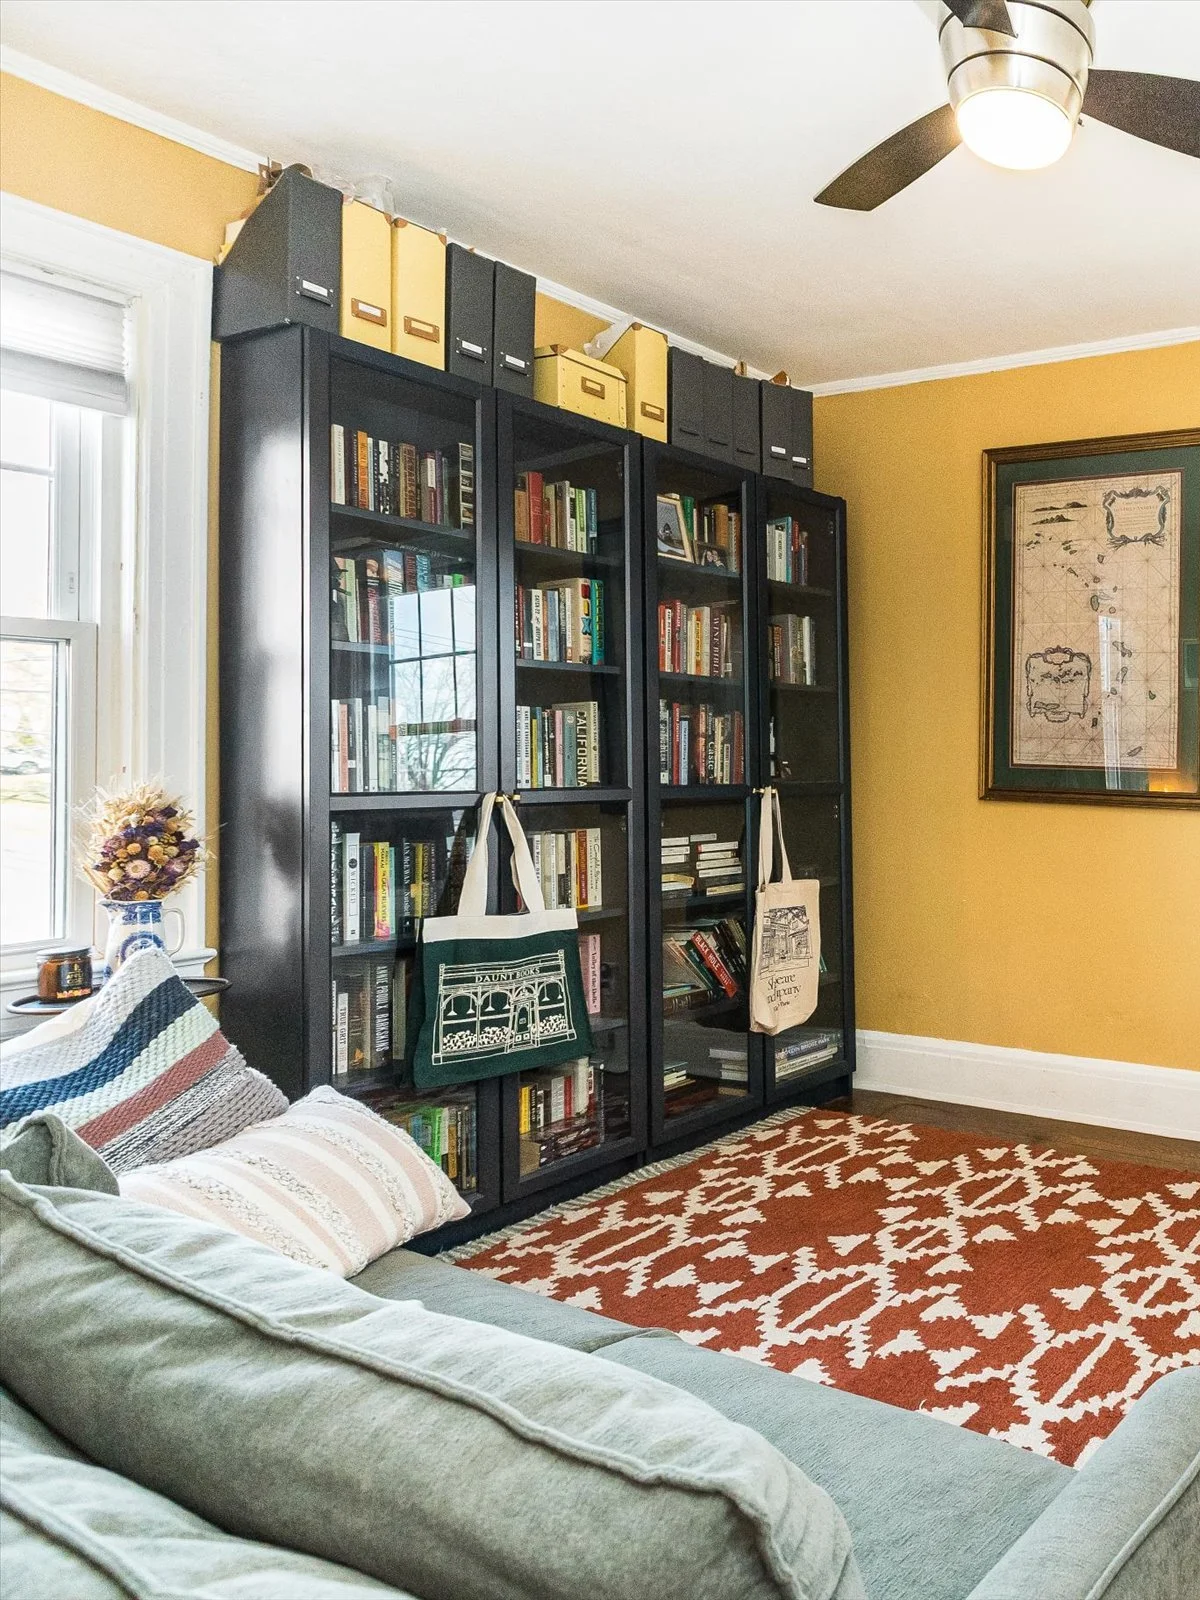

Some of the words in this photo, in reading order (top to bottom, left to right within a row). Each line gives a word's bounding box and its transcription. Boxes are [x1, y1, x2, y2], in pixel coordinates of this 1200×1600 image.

[712, 617, 720, 645] WINE
[712, 646, 720, 677] BIBLE
[576, 711, 588, 788] CALIFORNIA
[707, 741, 716, 771] Caste
[403, 842, 411, 854] IAN
[591, 844, 601, 869] Complete
[403, 855, 411, 884] McEWAN
[350, 871, 358, 904] WICKED
[403, 891, 411, 917] Nutshell
[694, 934, 711, 955] BLACK
[707, 953, 721, 971] HOLE
[475, 972, 514, 983] DAUNT
[516, 966, 540, 979] BOOKS
[376, 985, 389, 1011] PROULX
[339, 1008, 347, 1026] TRUE
[339, 1027, 347, 1045] GRIT
[375, 1012, 390, 1052] BARKSKINS
